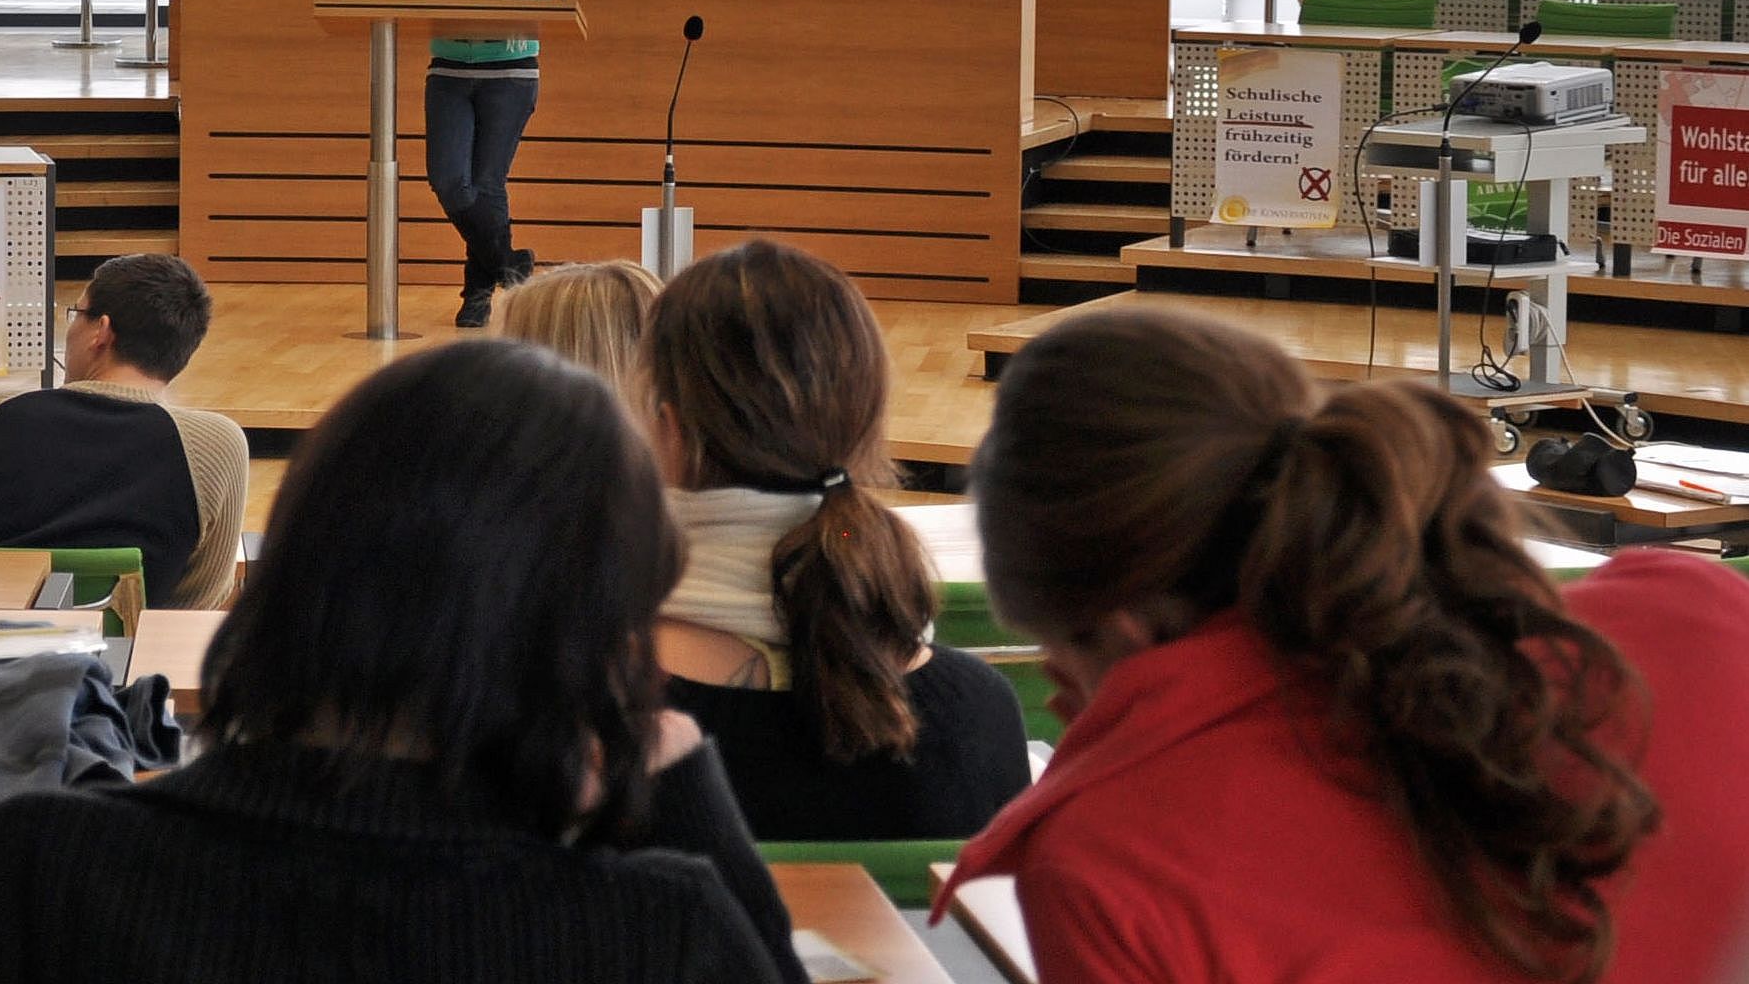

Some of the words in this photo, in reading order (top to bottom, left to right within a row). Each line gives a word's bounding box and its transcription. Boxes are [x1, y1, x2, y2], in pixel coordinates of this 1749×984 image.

[1225, 87, 1323, 104] Schulische
[1226, 108, 1305, 124] Leistung
[1225, 127, 1314, 148] frühzeitig
[1224, 148, 1300, 165] fördern!
[1679, 160, 1707, 184] für
[1657, 226, 1681, 245] Die
[1684, 228, 1743, 250] Sozialen
